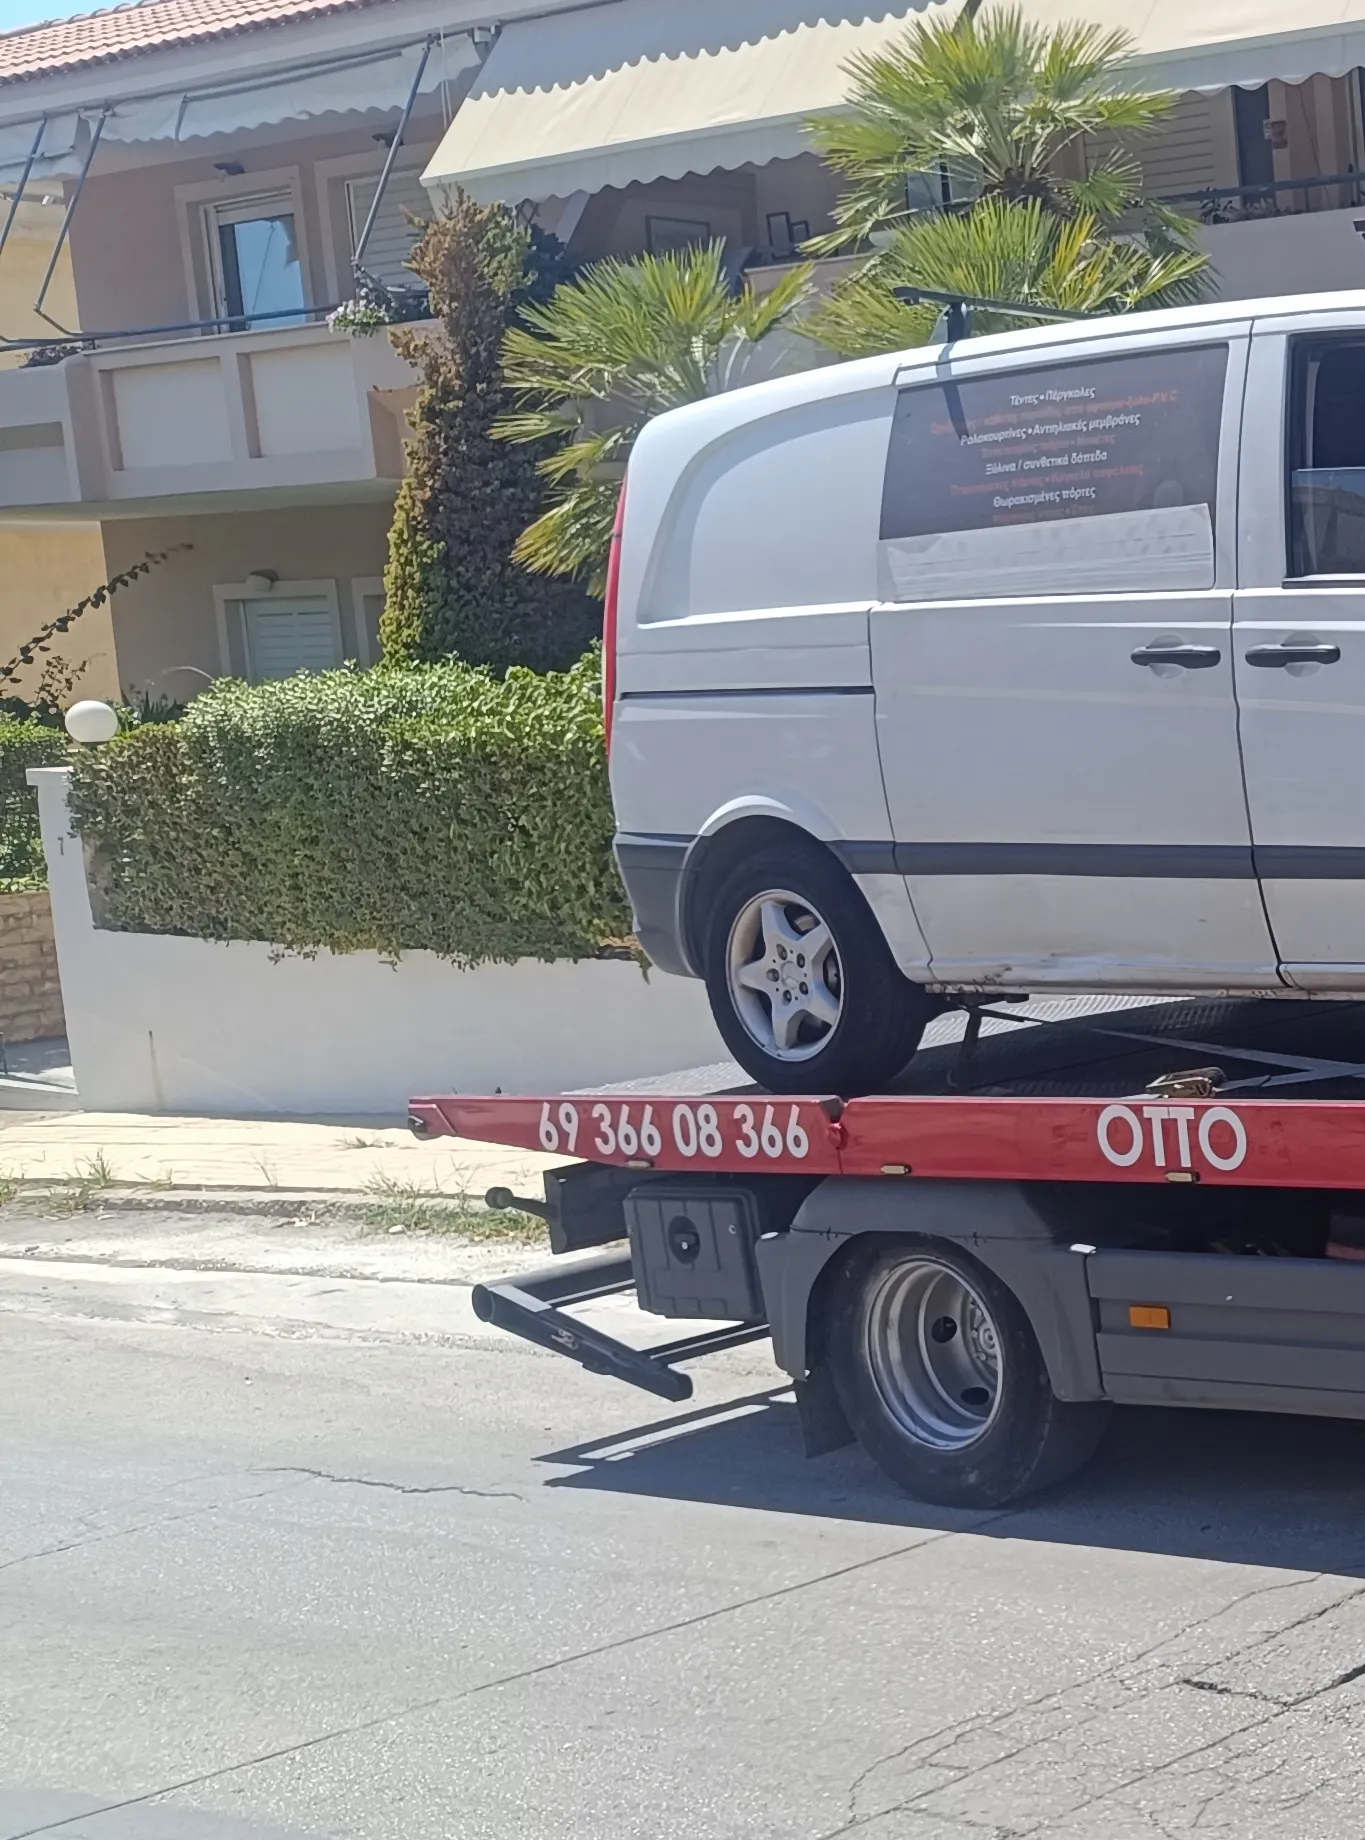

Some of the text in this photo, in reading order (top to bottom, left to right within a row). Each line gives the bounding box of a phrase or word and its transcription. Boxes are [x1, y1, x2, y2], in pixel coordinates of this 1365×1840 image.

[538, 1101, 809, 1159] 69 366 08 366
[1096, 1104, 1248, 1171] OTTO
